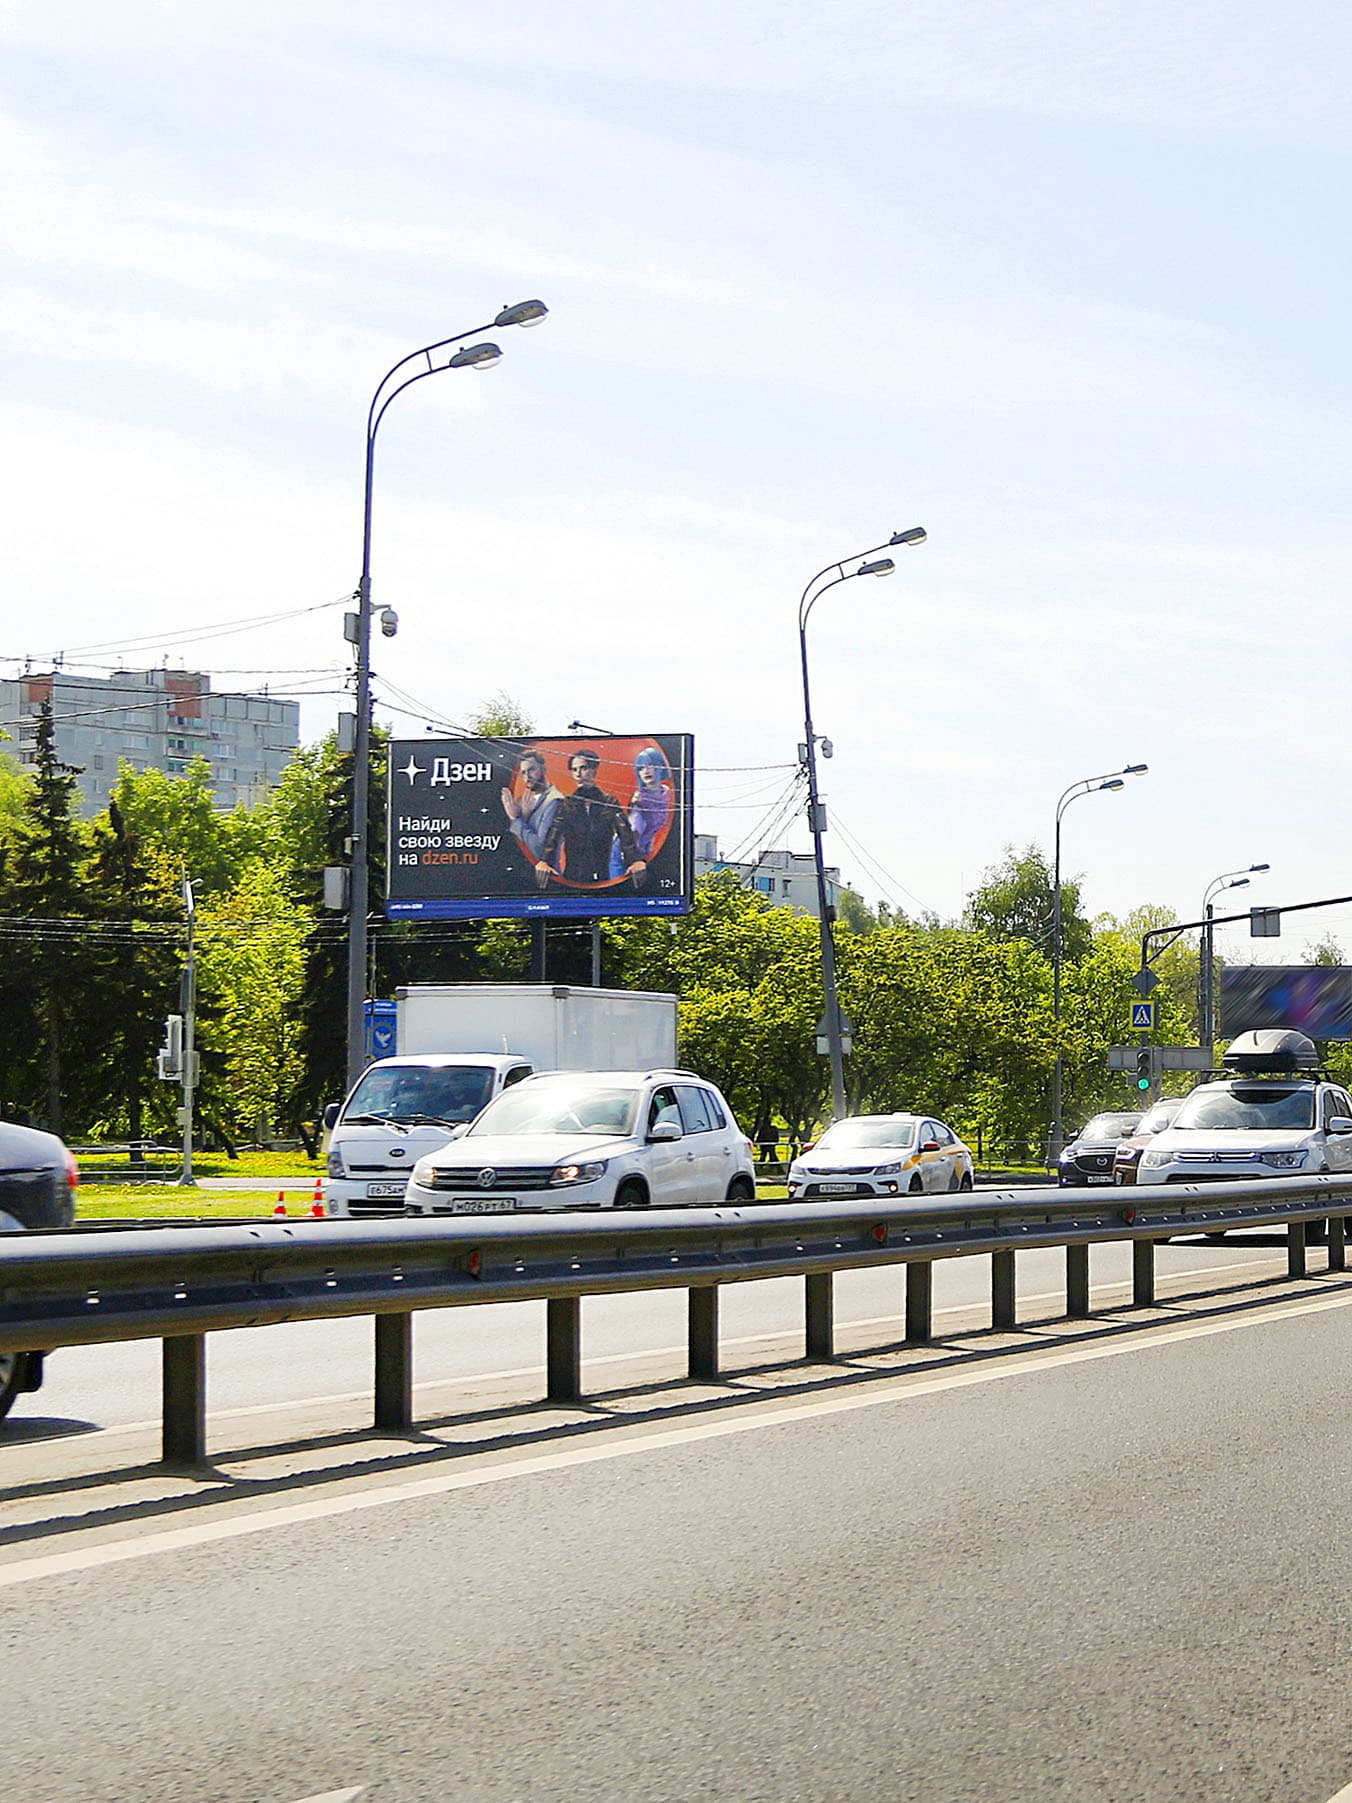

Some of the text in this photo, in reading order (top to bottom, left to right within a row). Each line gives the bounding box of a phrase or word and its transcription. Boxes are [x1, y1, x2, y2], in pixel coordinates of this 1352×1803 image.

[430, 757, 492, 787] Дзен
[399, 816, 451, 833] Найди
[399, 835, 501, 851] свою звезду
[399, 850, 479, 865] на dzen.ru
[660, 879, 676, 888] 12+
